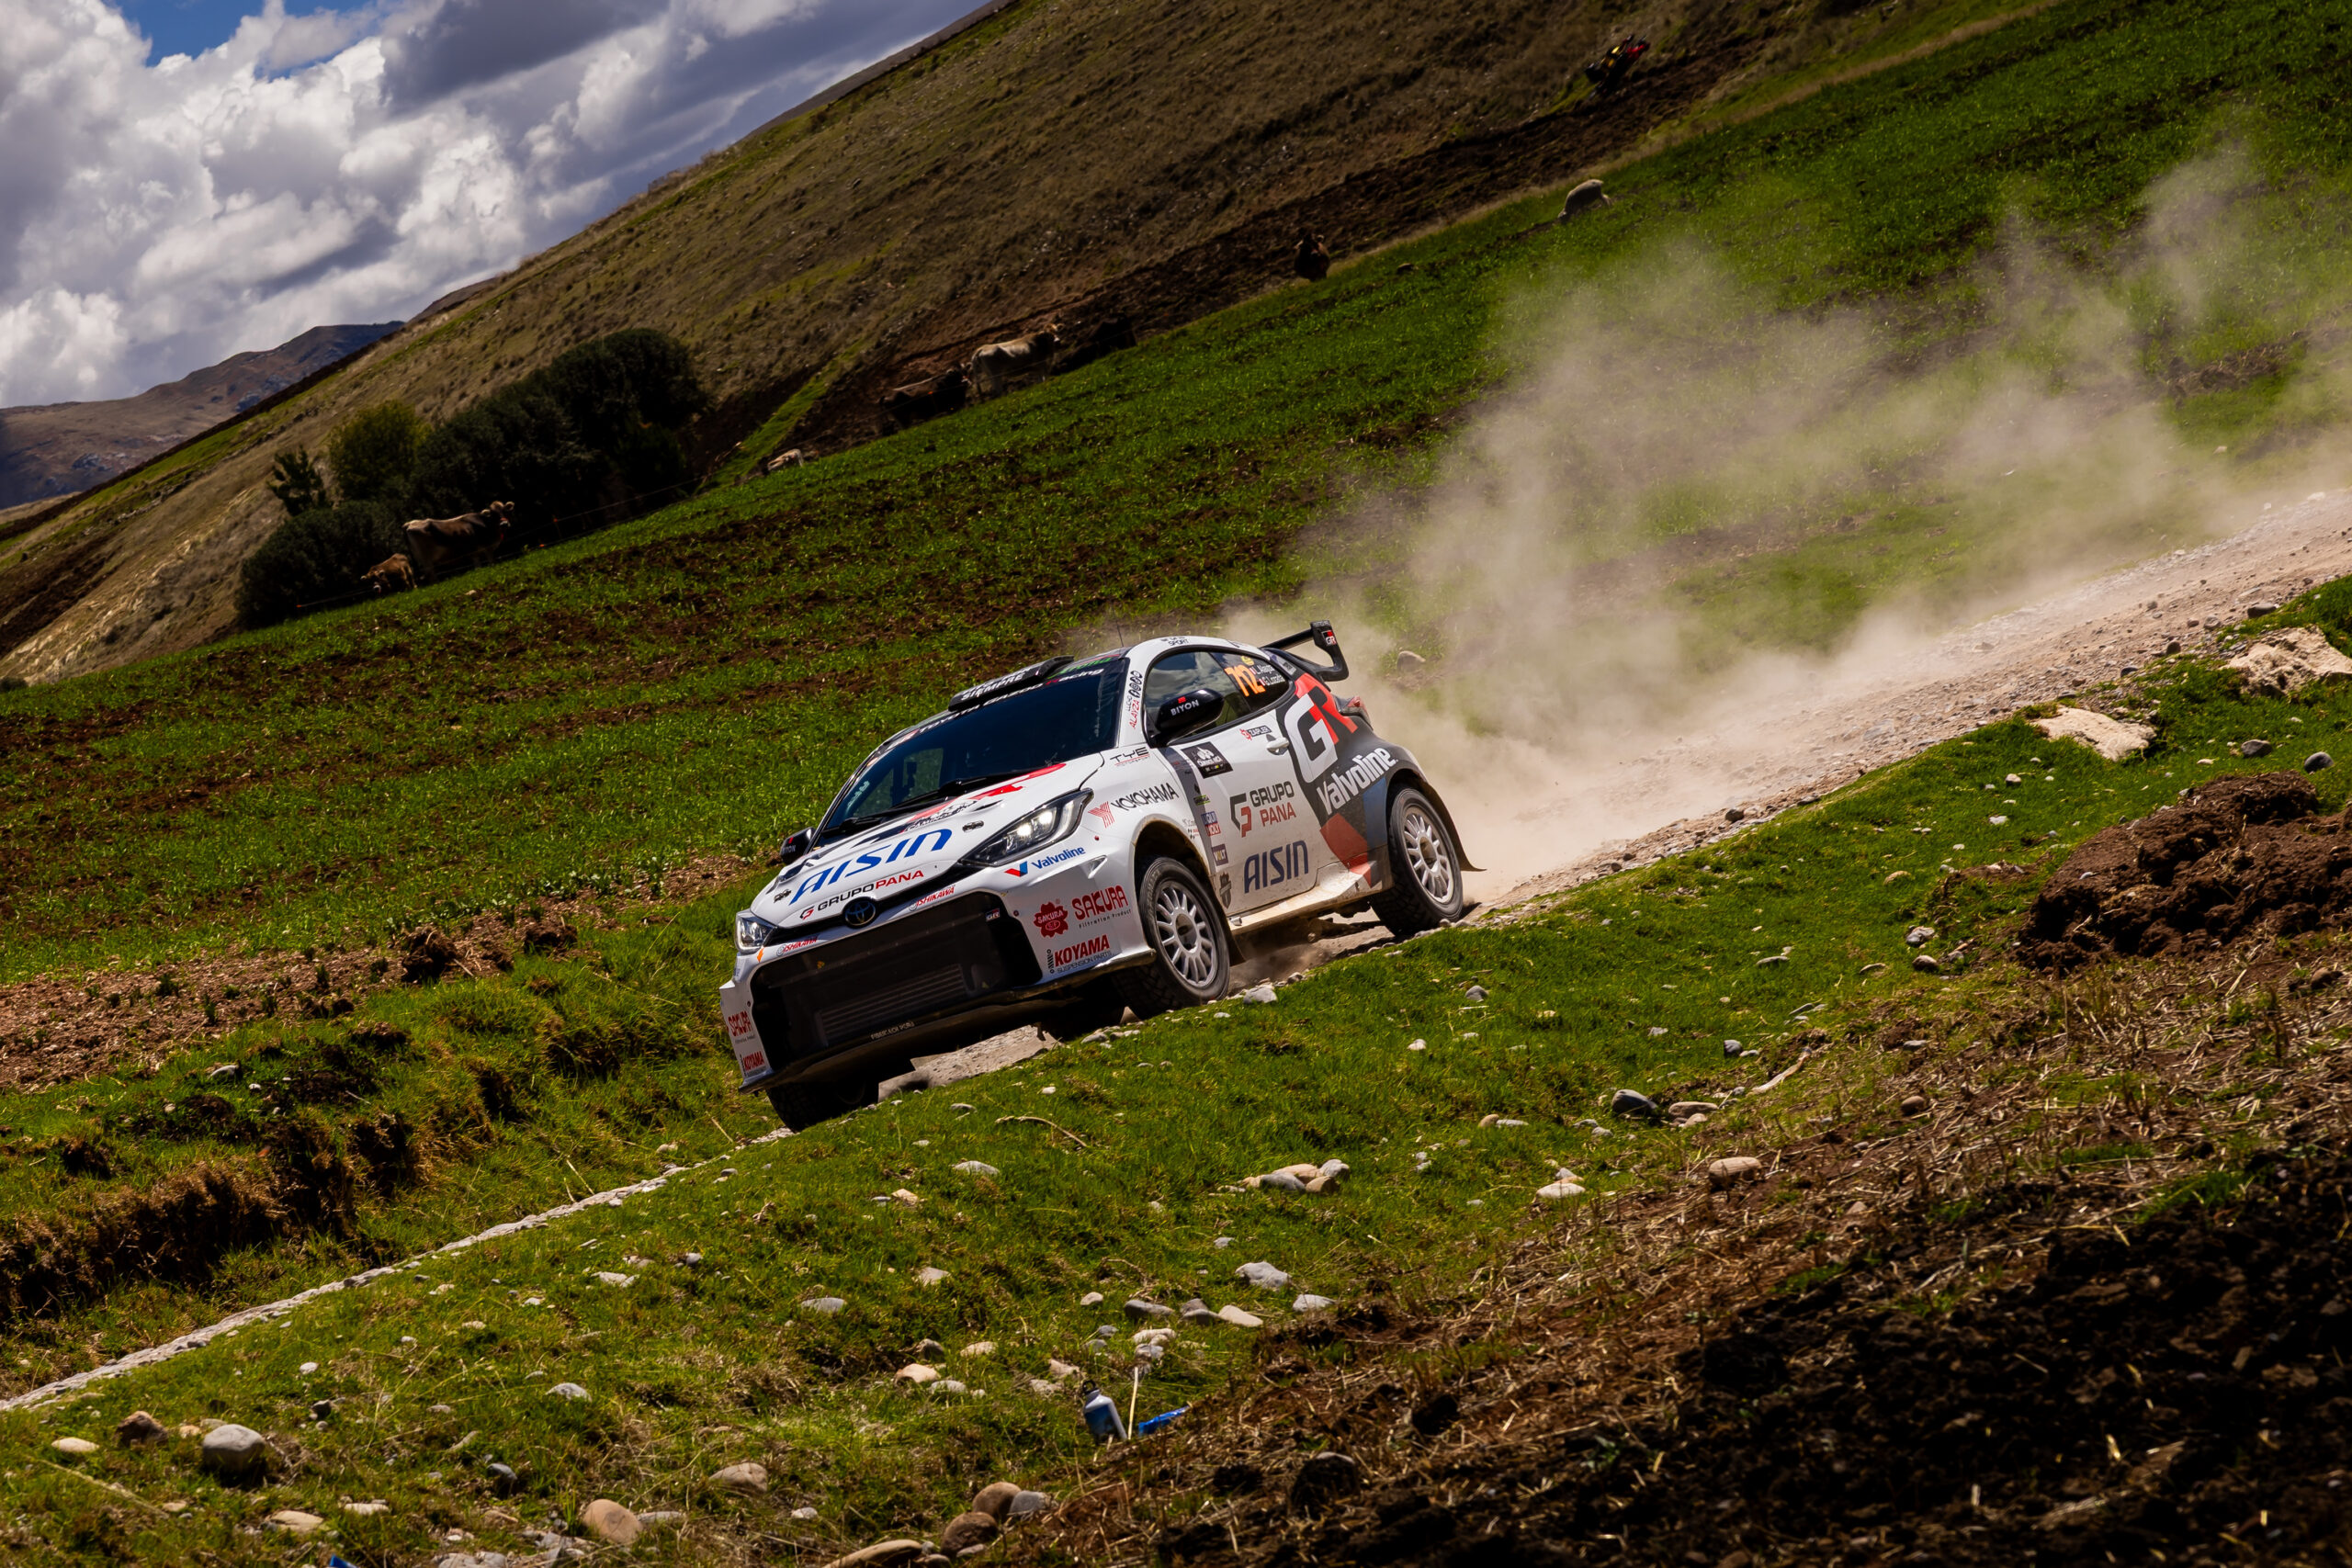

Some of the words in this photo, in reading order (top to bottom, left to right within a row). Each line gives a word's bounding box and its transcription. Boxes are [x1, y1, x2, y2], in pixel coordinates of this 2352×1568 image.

[1325, 636, 1337, 646] GR
[1170, 700, 1200, 716] BIYON
[1110, 747, 1149, 762] TYE
[1317, 747, 1396, 816] Valvoline
[1111, 783, 1180, 812] YOKOHAMA
[1250, 781, 1295, 807] GRUPO
[1260, 802, 1296, 827] PANA
[788, 829, 953, 906] AISIN
[1032, 846, 1086, 870] Valvoline
[1244, 840, 1309, 894] AISIN
[916, 886, 956, 907] ISHIKAWA
[1071, 885, 1129, 920] SAKURA
[1037, 909, 1064, 924] SAKURA
[783, 938, 817, 953] ISHIKAWA
[1054, 934, 1110, 967] KOYAMA
[1057, 958, 1093, 974] SUSPENSION
[1093, 951, 1113, 962] PARTS
